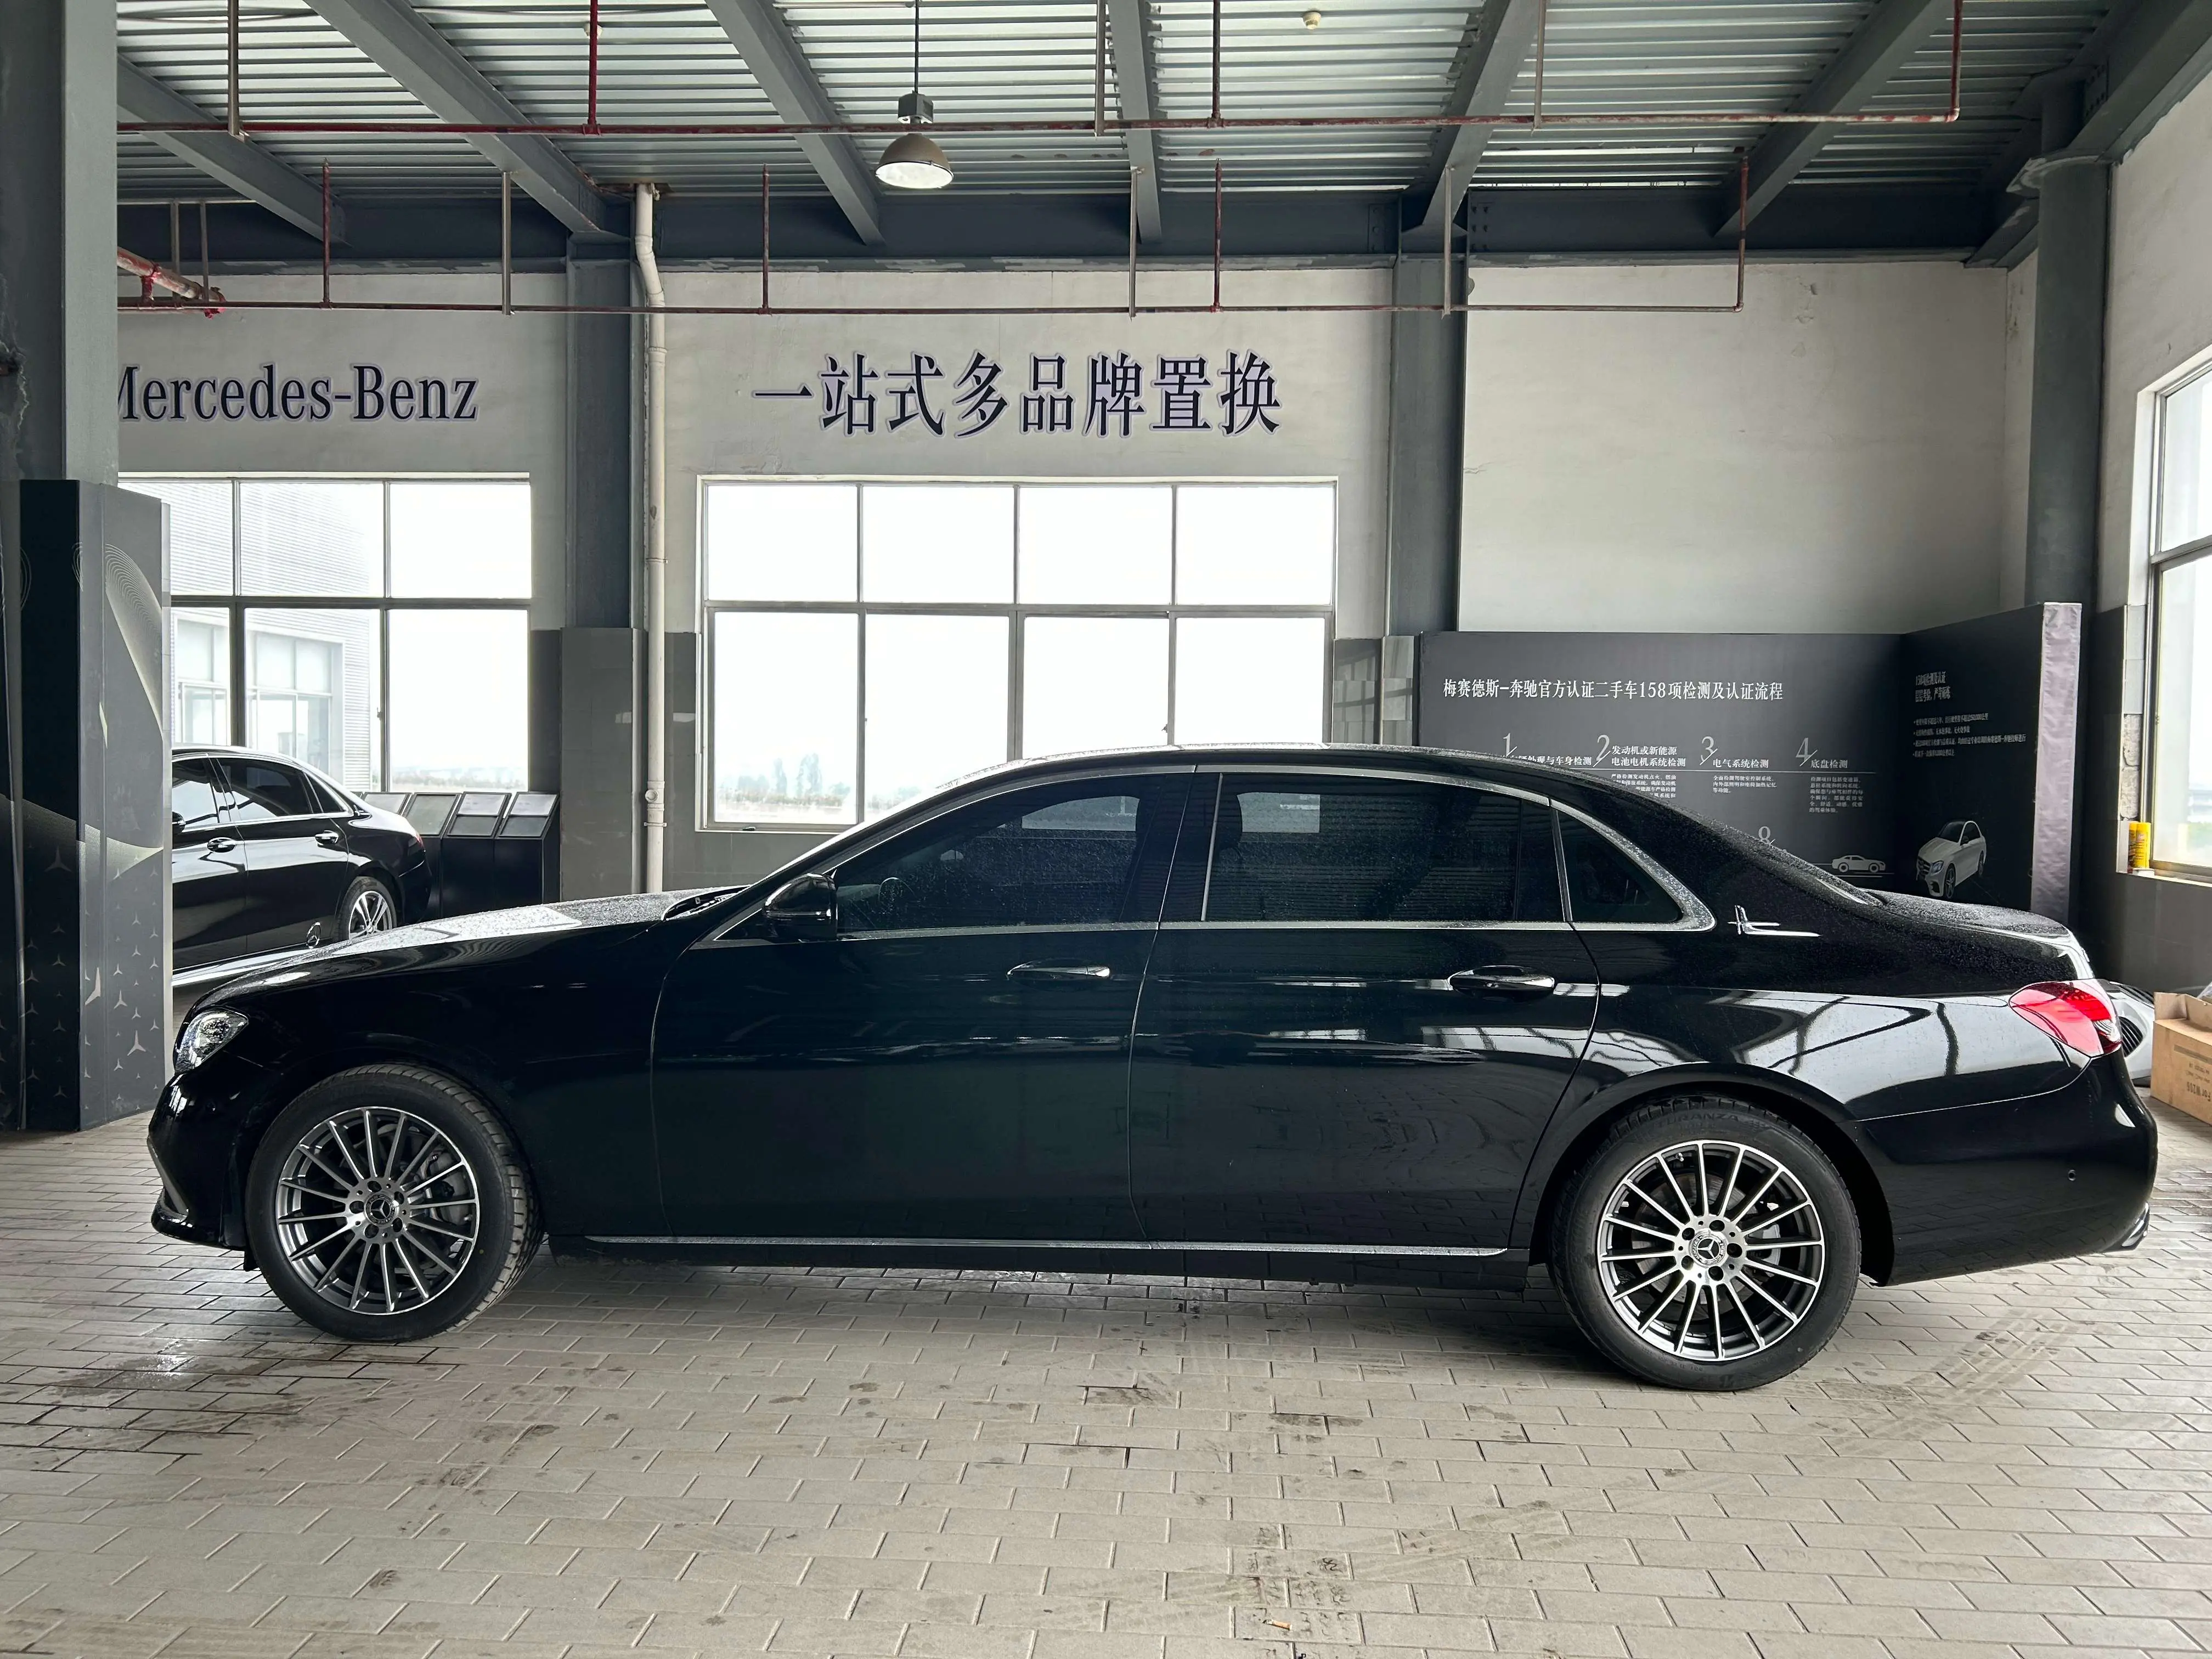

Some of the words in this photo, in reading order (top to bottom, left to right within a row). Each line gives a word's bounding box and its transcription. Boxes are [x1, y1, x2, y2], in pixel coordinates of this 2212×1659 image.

[117, 362, 477, 420] Mercedes-Benz
[754, 352, 1281, 437] 一站式多品牌置换
[1503, 732, 1511, 757] 1
[1596, 735, 1610, 762] 2
[1612, 745, 1677, 755] 发动机或新能源
[1701, 736, 1714, 762] 3
[1796, 737, 1812, 762] 4
[1611, 757, 1686, 767] 电池电机系统检测
[1713, 759, 1769, 768] 电气系统检测
[1811, 759, 1848, 768] 底盘检测
